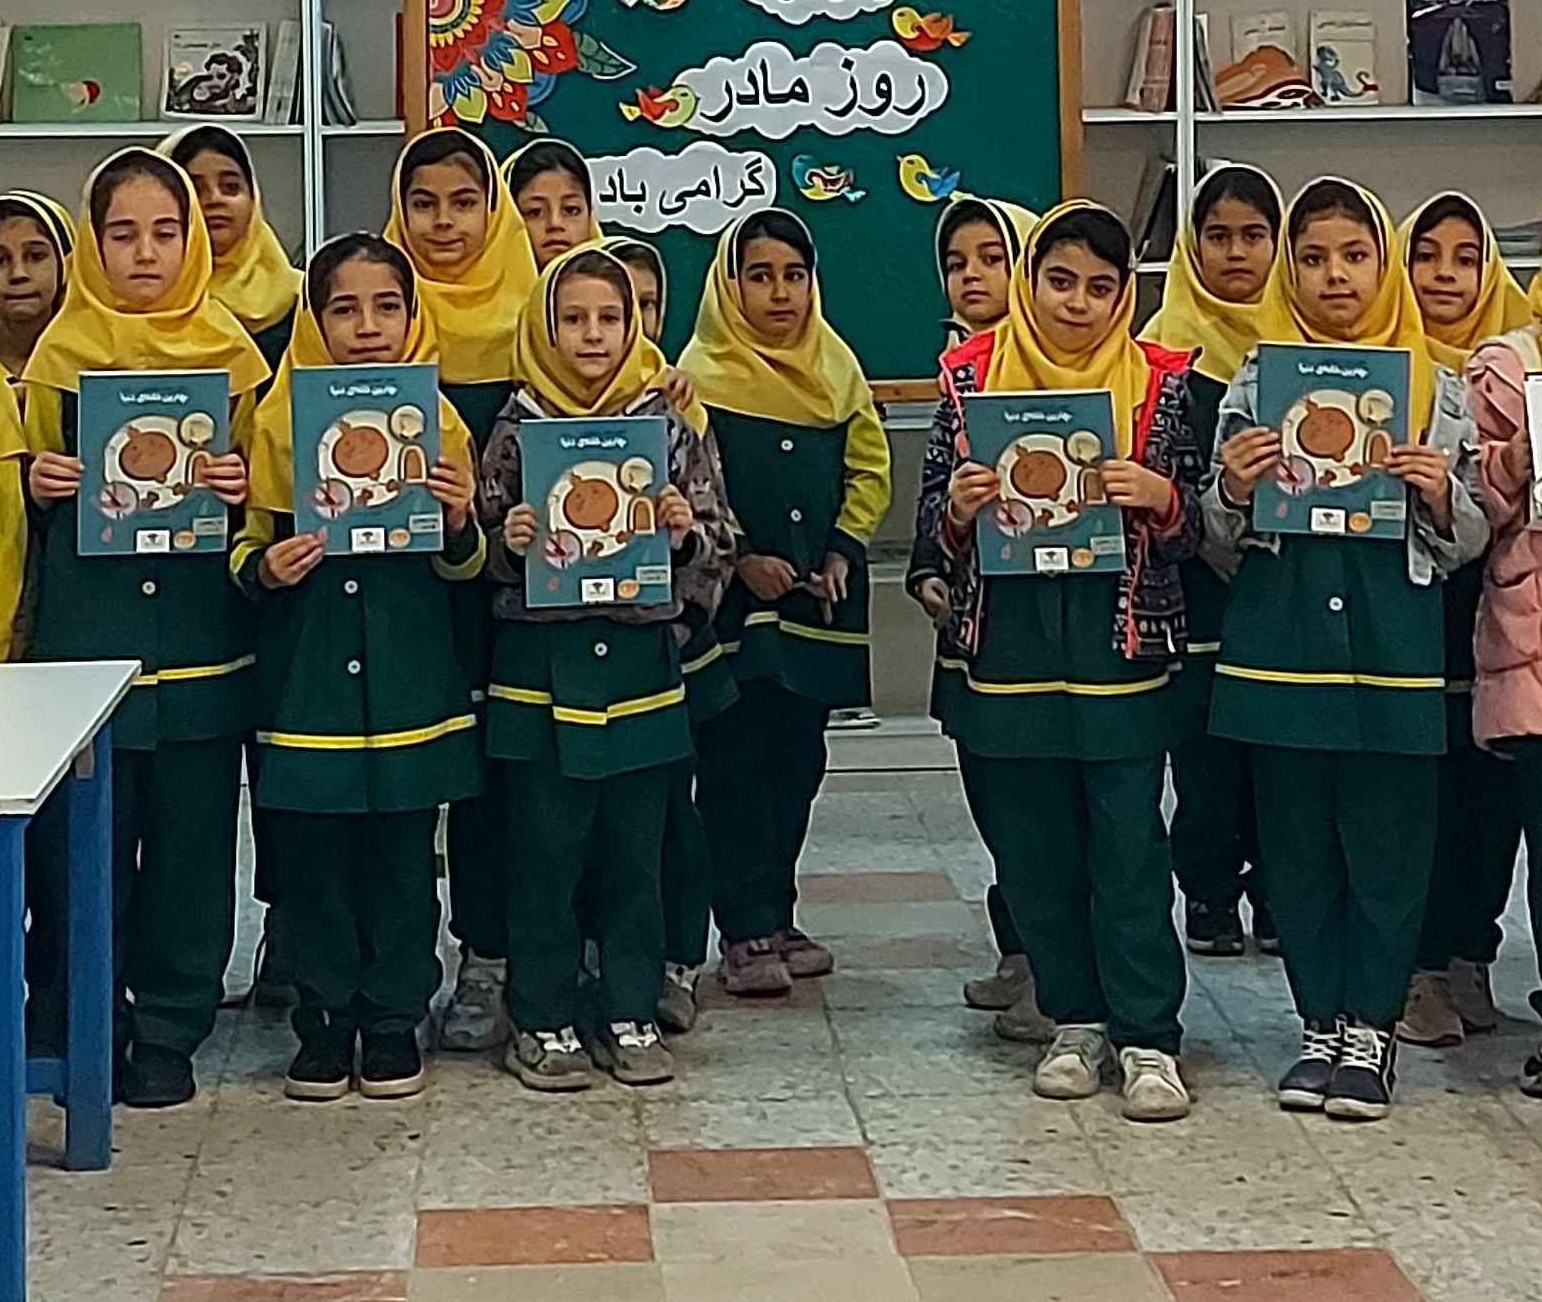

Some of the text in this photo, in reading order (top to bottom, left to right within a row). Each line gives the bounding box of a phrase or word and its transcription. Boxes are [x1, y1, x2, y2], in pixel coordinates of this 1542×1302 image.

[699, 57, 927, 122] روز مادر
[599, 157, 766, 216] گرامی باد
